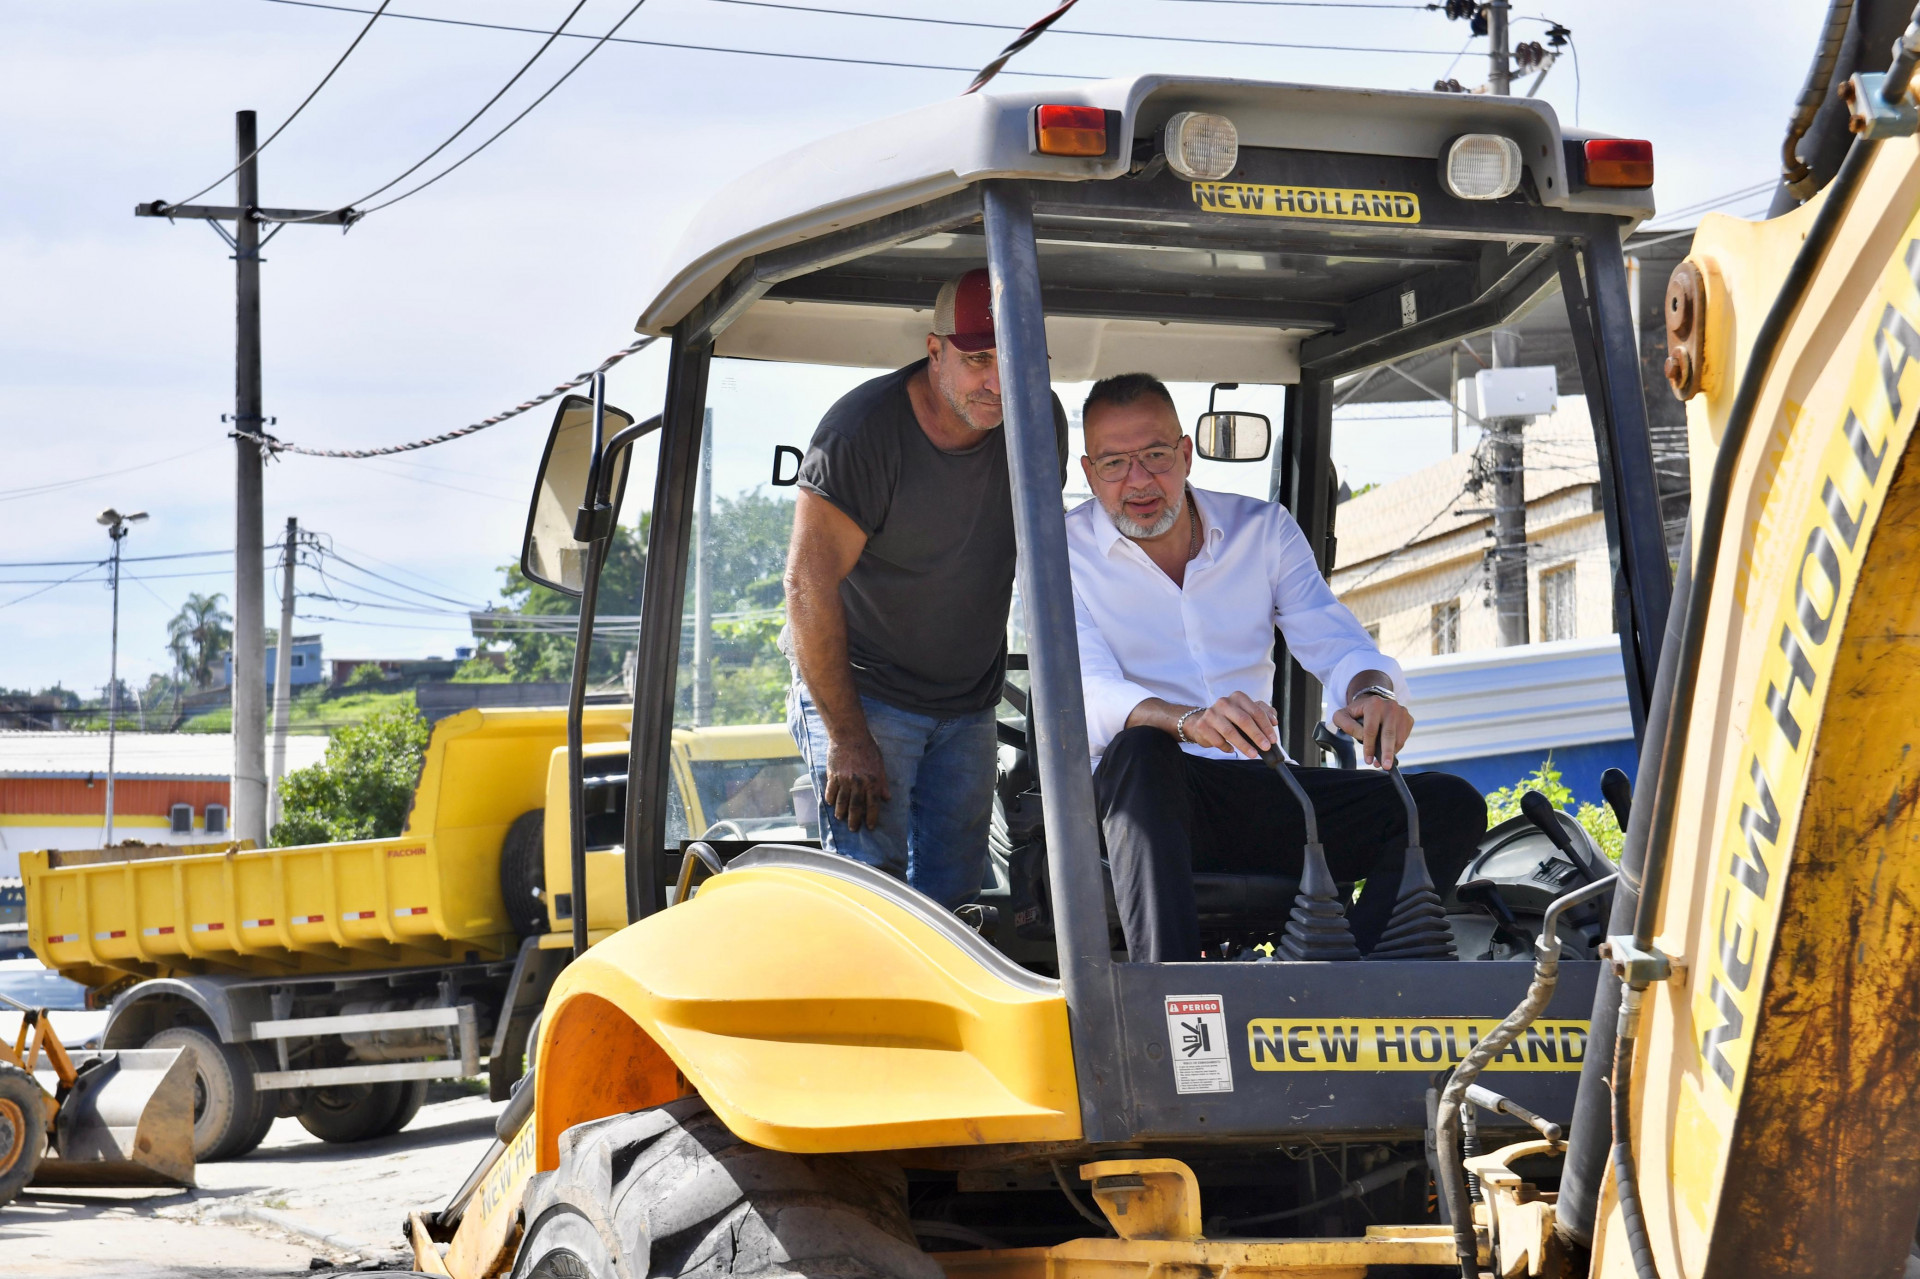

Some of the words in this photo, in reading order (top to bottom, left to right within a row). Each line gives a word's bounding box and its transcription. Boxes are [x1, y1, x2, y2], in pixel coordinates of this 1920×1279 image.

[1194, 184, 1265, 209] NEW
[1275, 189, 1414, 218] HOLLAND
[1701, 752, 1781, 1093] NEW
[1182, 1003, 1217, 1011] PERIGO
[1252, 1025, 1359, 1063] NEW
[482, 1153, 511, 1221] NEW
